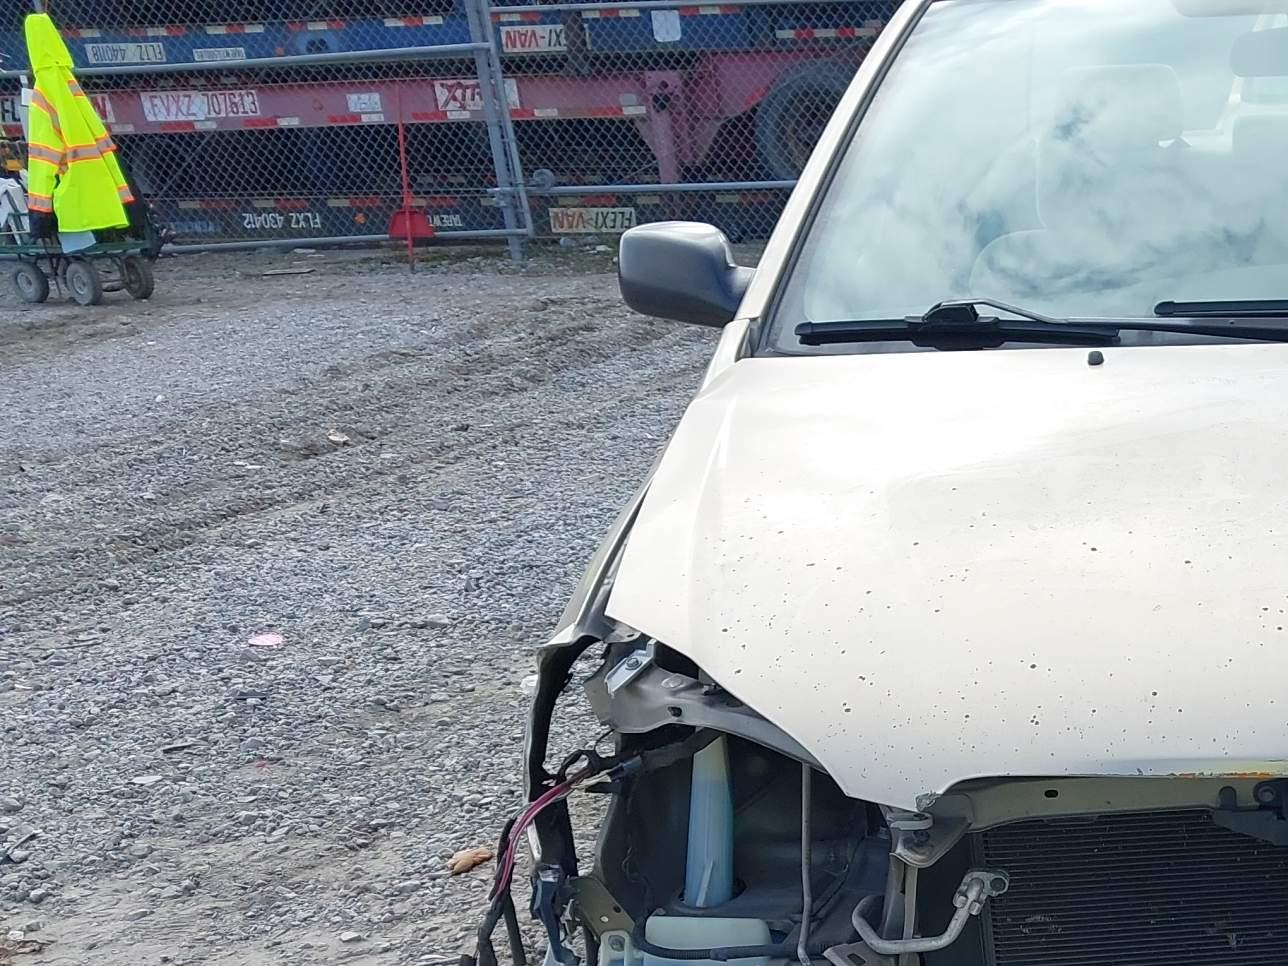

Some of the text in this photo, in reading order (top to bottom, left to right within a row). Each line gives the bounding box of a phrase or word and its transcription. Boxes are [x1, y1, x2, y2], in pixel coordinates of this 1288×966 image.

[149, 91, 258, 119] FVXZ 707613
[242, 212, 322, 229] FLXZ 430412
